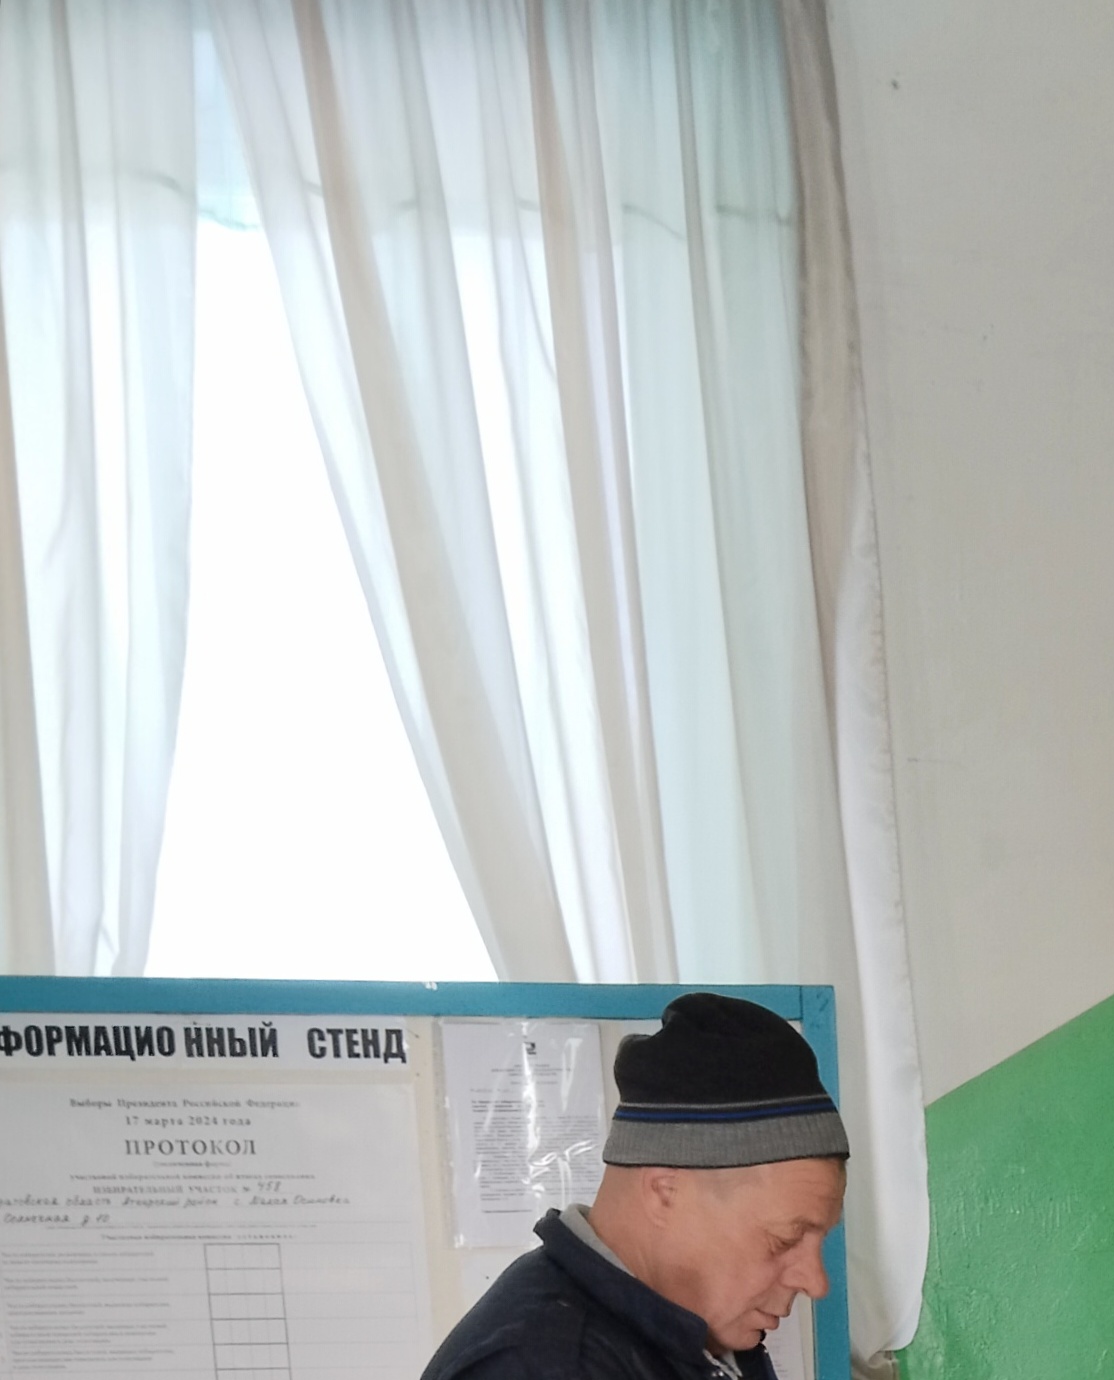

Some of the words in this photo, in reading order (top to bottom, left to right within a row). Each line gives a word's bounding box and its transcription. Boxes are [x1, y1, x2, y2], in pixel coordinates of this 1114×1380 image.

[306, 1027, 407, 1063] СТЕНД
[69, 1098, 112, 1109] Выборы
[125, 1115, 139, 1126] 17
[144, 1118, 183, 1128] марта
[188, 1115, 218, 1126] 2024
[222, 1118, 251, 1126] года
[124, 1139, 257, 1156] ПРОТОКОЛ
